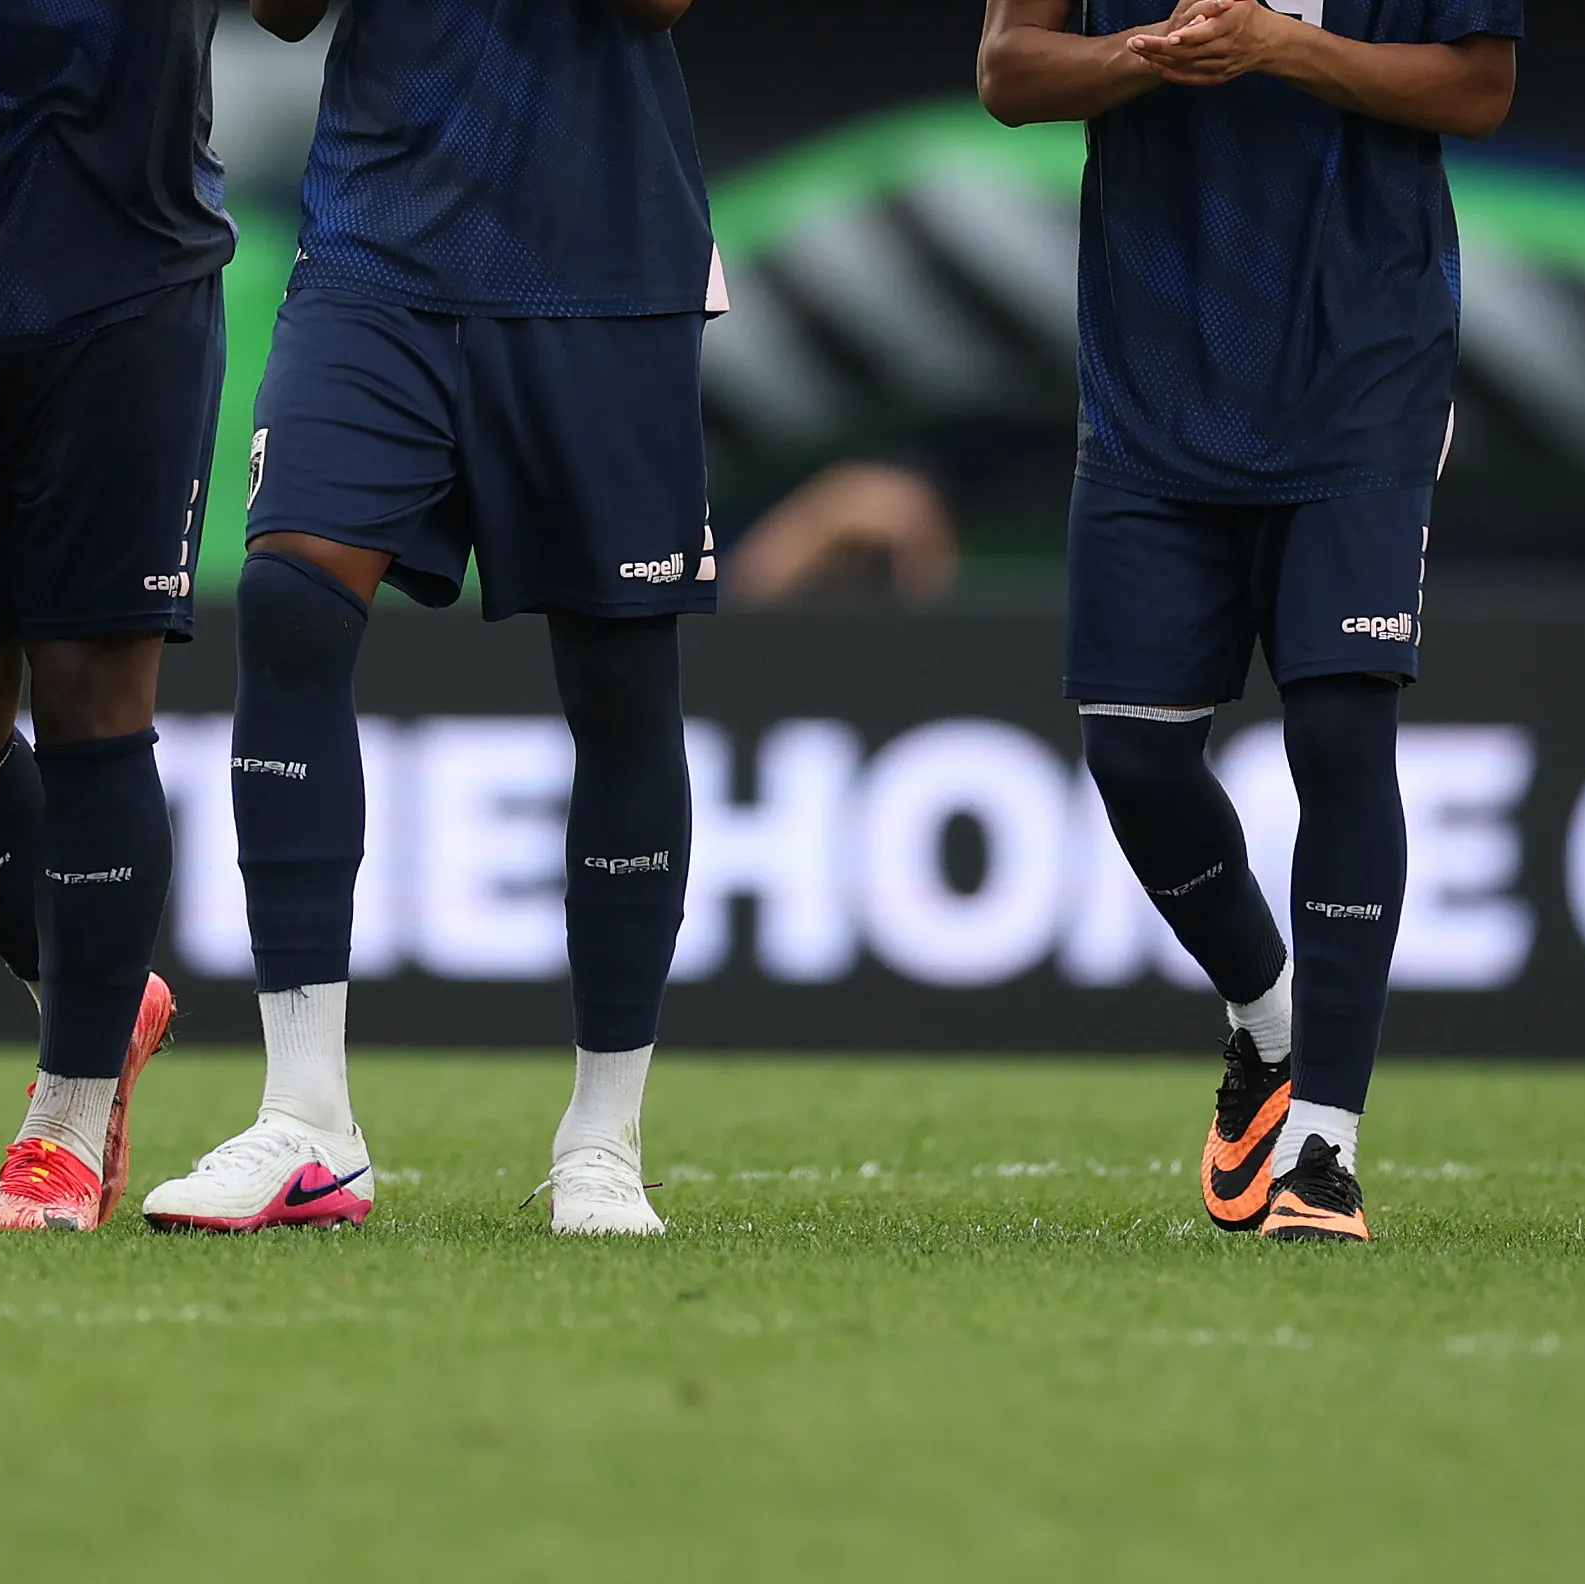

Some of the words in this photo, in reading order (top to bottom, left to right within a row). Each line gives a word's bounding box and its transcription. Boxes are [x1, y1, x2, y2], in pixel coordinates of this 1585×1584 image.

[619, 552, 684, 583] capelli
[1341, 612, 1412, 638] capelli
[1378, 631, 1411, 643] SPORT
[584, 850, 669, 875] capelli
[1305, 900, 1383, 918] capelli
